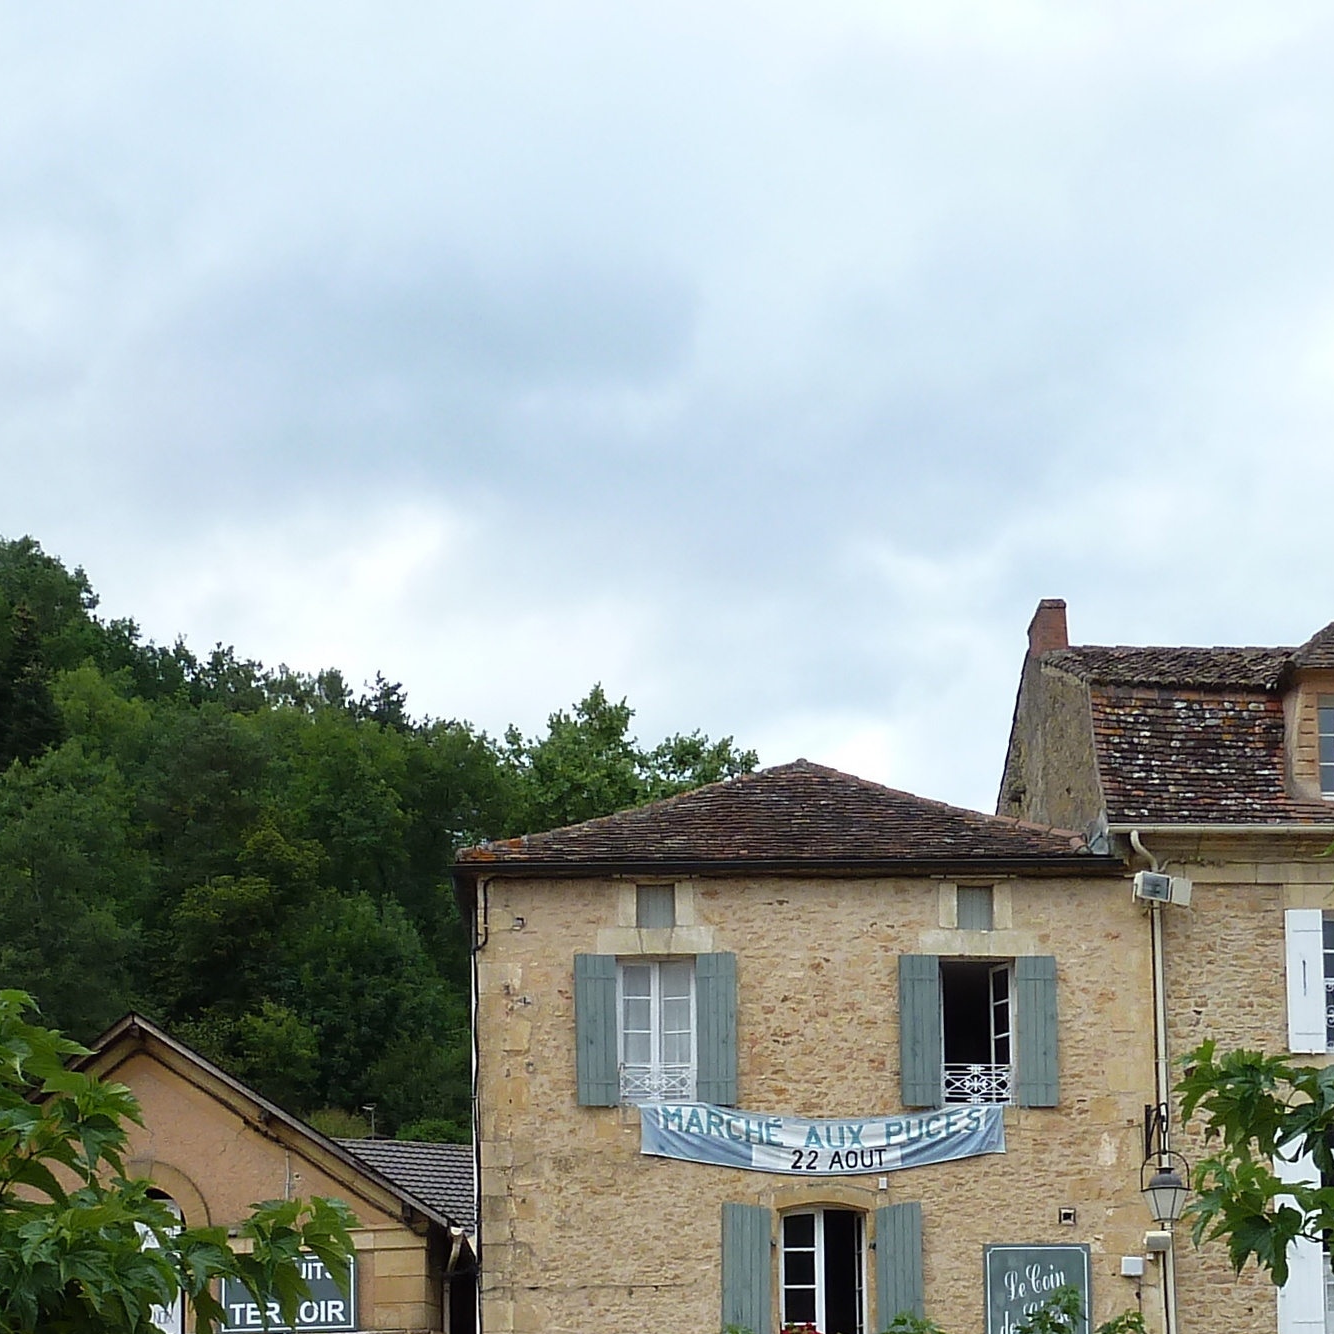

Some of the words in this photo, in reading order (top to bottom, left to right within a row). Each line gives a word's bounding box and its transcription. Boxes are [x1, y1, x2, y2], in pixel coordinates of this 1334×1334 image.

[661, 1106, 783, 1146] MARCHÉ
[804, 1124, 864, 1149] AUX
[884, 1107, 983, 1146] PUCES
[790, 1149, 818, 1170] 22
[829, 1148, 887, 1170] AOUT
[1004, 1270, 1027, 1301] Le
[1025, 1263, 1066, 1294] Coin
[229, 1300, 346, 1325] TEROIR
